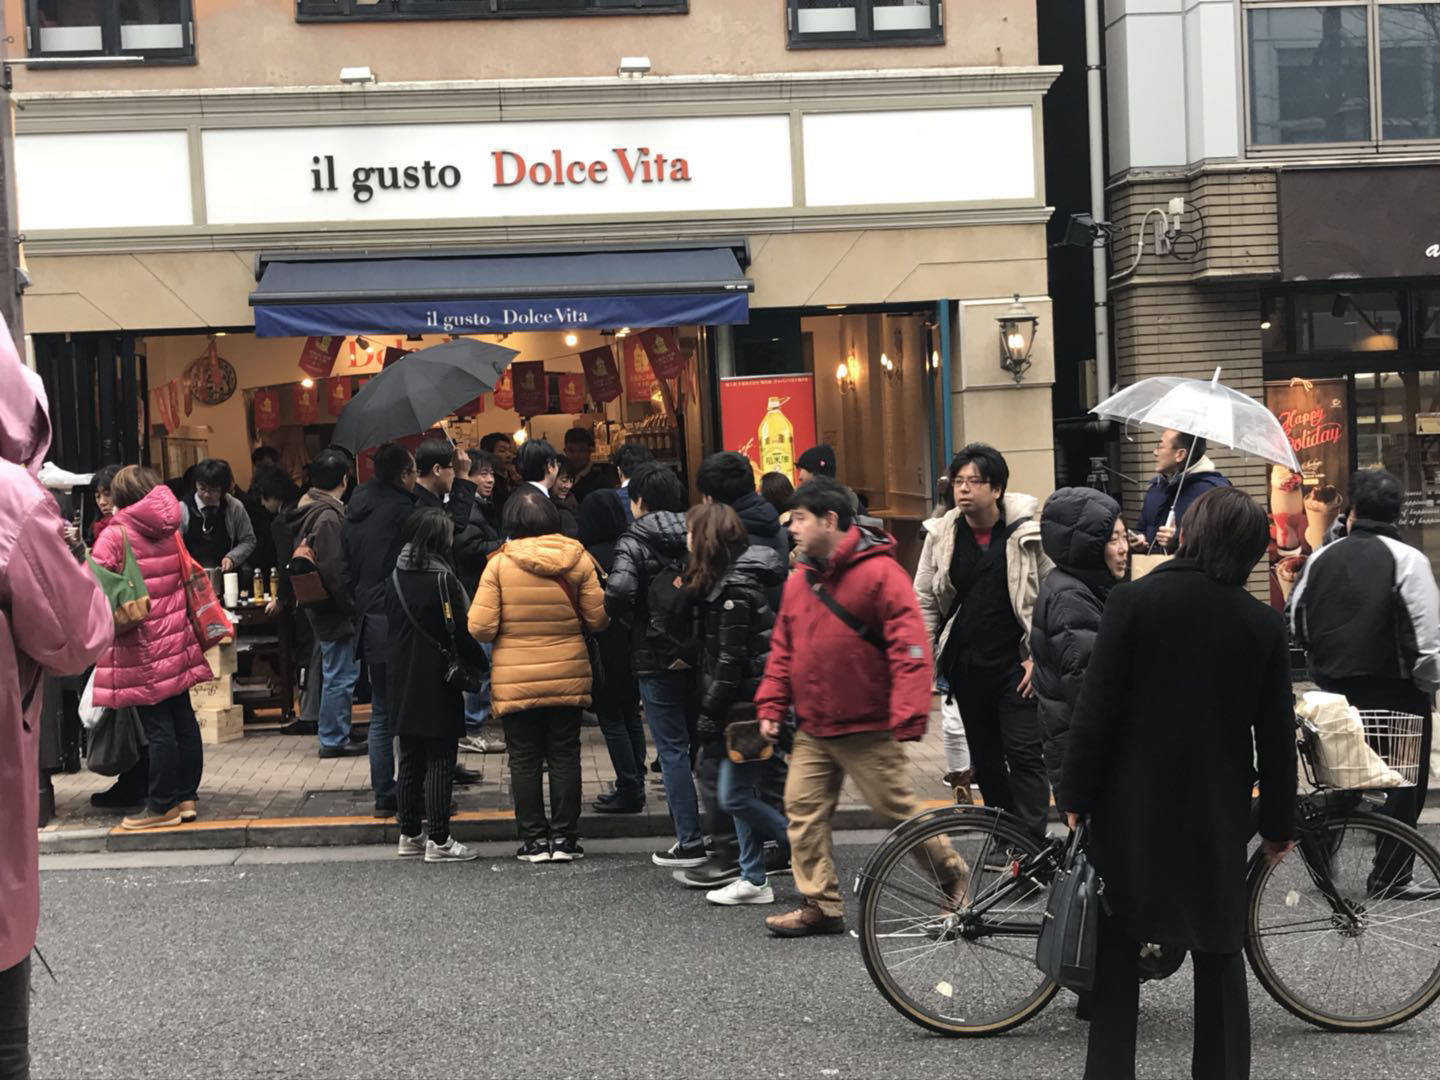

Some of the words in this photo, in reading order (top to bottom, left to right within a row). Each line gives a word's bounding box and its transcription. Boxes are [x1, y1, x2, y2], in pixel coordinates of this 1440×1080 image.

[310, 155, 338, 192] il
[352, 160, 462, 203] gusto
[491, 149, 608, 188] Dolce
[612, 147, 692, 183] Vita
[426, 311, 437, 327] il
[443, 313, 491, 331] gusto
[503, 308, 553, 325] Dolce
[555, 307, 588, 324] Vita
[1279, 407, 1326, 428] Happy
